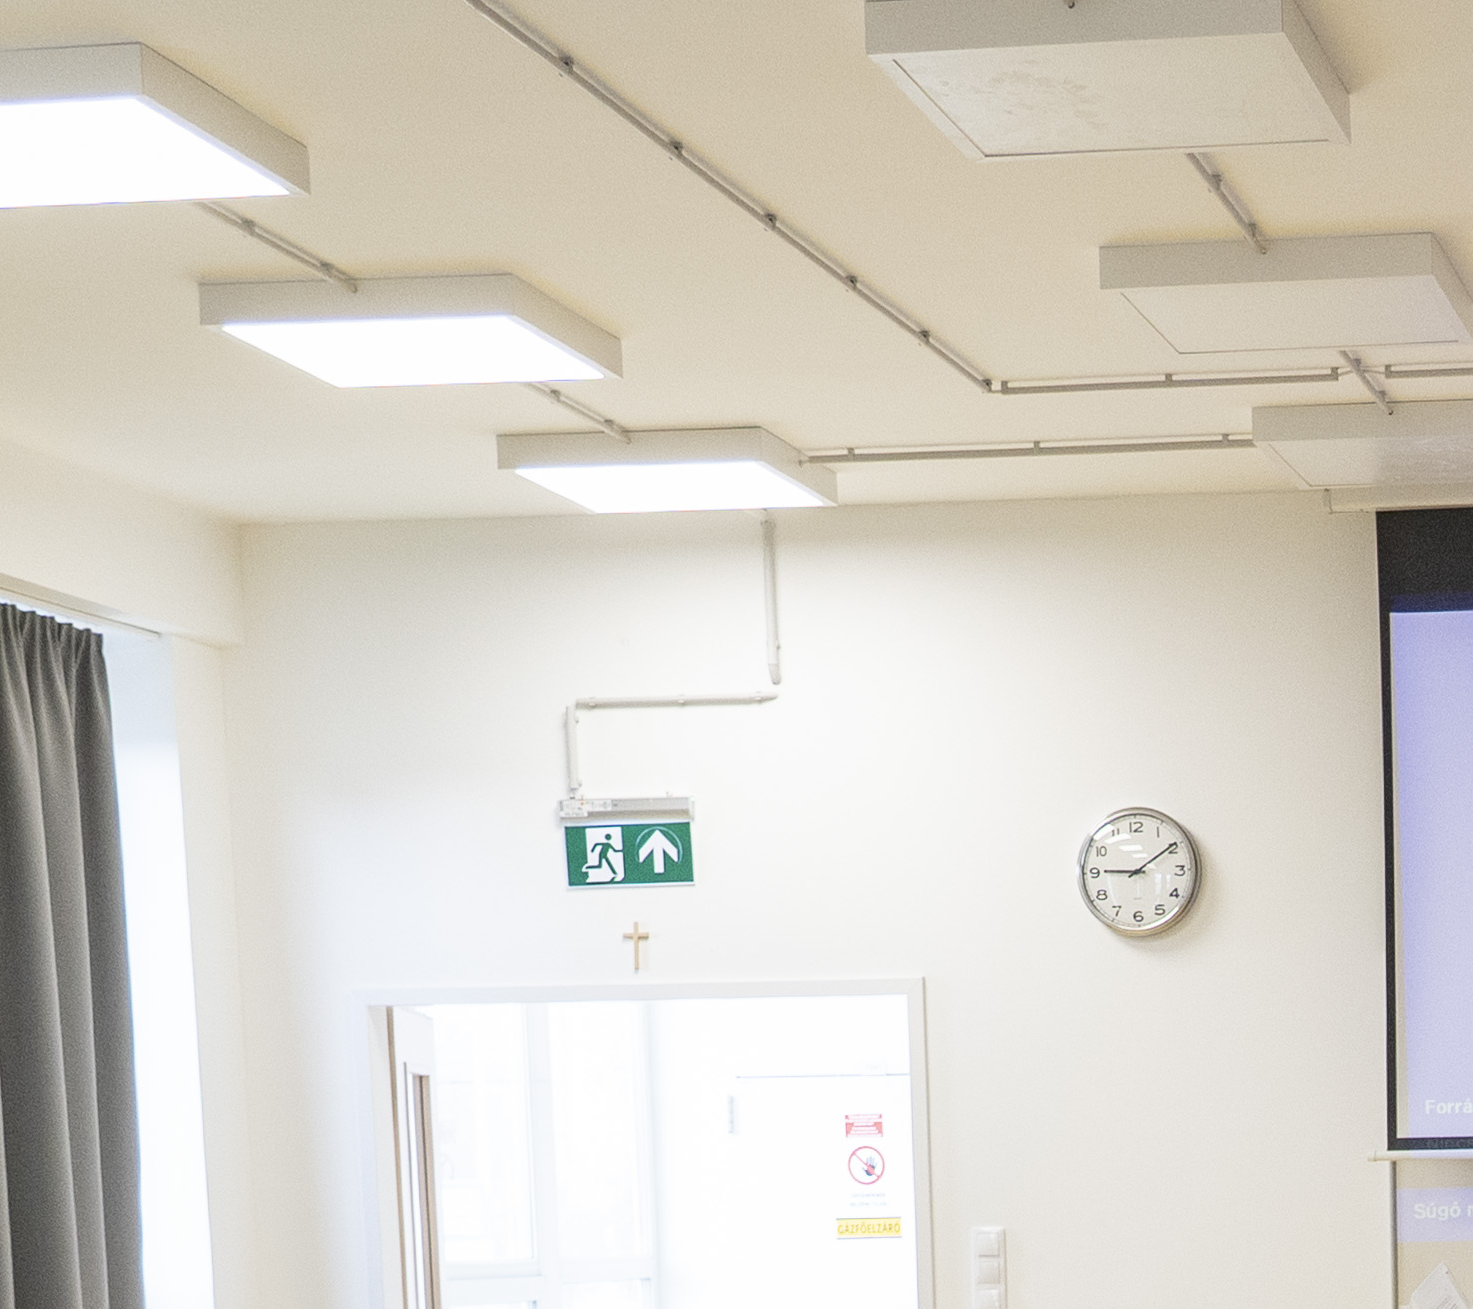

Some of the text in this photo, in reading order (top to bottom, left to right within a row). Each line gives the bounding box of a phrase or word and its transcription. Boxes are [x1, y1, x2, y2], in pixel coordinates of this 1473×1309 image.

[1111, 828, 1120, 837] 11
[1129, 821, 1144, 834] 12
[1156, 826, 1161, 838] 1
[1095, 845, 1108, 857] 10
[1089, 867, 1101, 879] 9
[1174, 865, 1186, 877] 3
[1096, 889, 1108, 901] 8
[1169, 888, 1180, 899] 4
[1112, 905, 1122, 917] 7
[1154, 904, 1166, 916] 5
[1133, 911, 1145, 923] 6
[1413, 1201, 1462, 1221] Súgó
[837, 1220, 901, 1235] GÁZFŐELZÁRÓ
